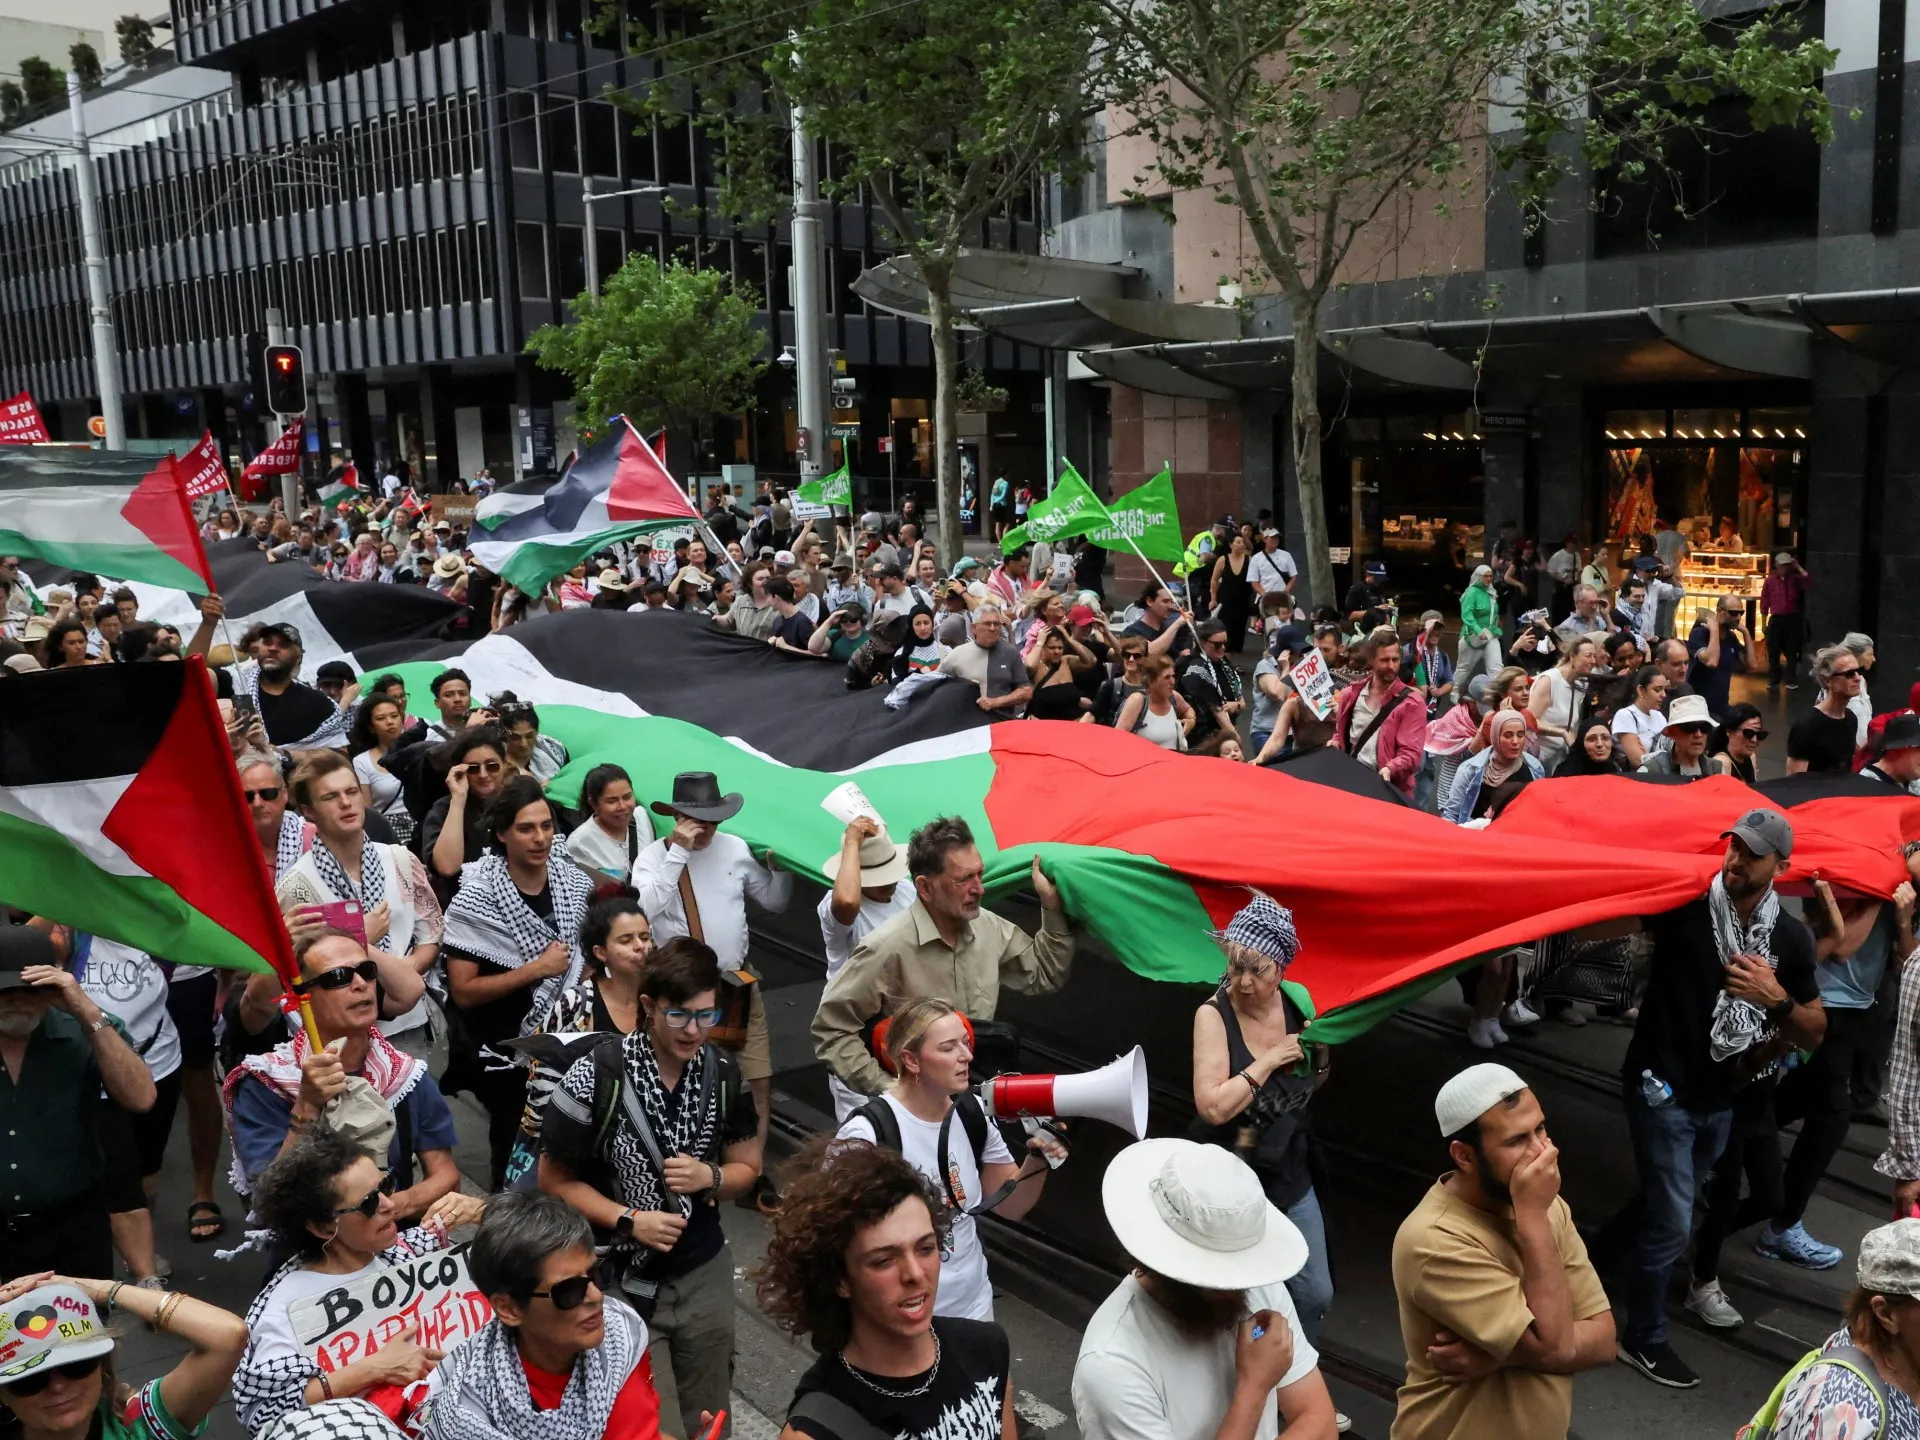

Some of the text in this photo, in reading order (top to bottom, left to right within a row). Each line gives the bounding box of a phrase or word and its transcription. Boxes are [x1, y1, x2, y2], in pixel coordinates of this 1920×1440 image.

[831, 427, 857, 437] George St
[1295, 655, 1319, 687] STOP
[53, 1296, 90, 1317] ACAB
[58, 1319, 95, 1338] BLM
